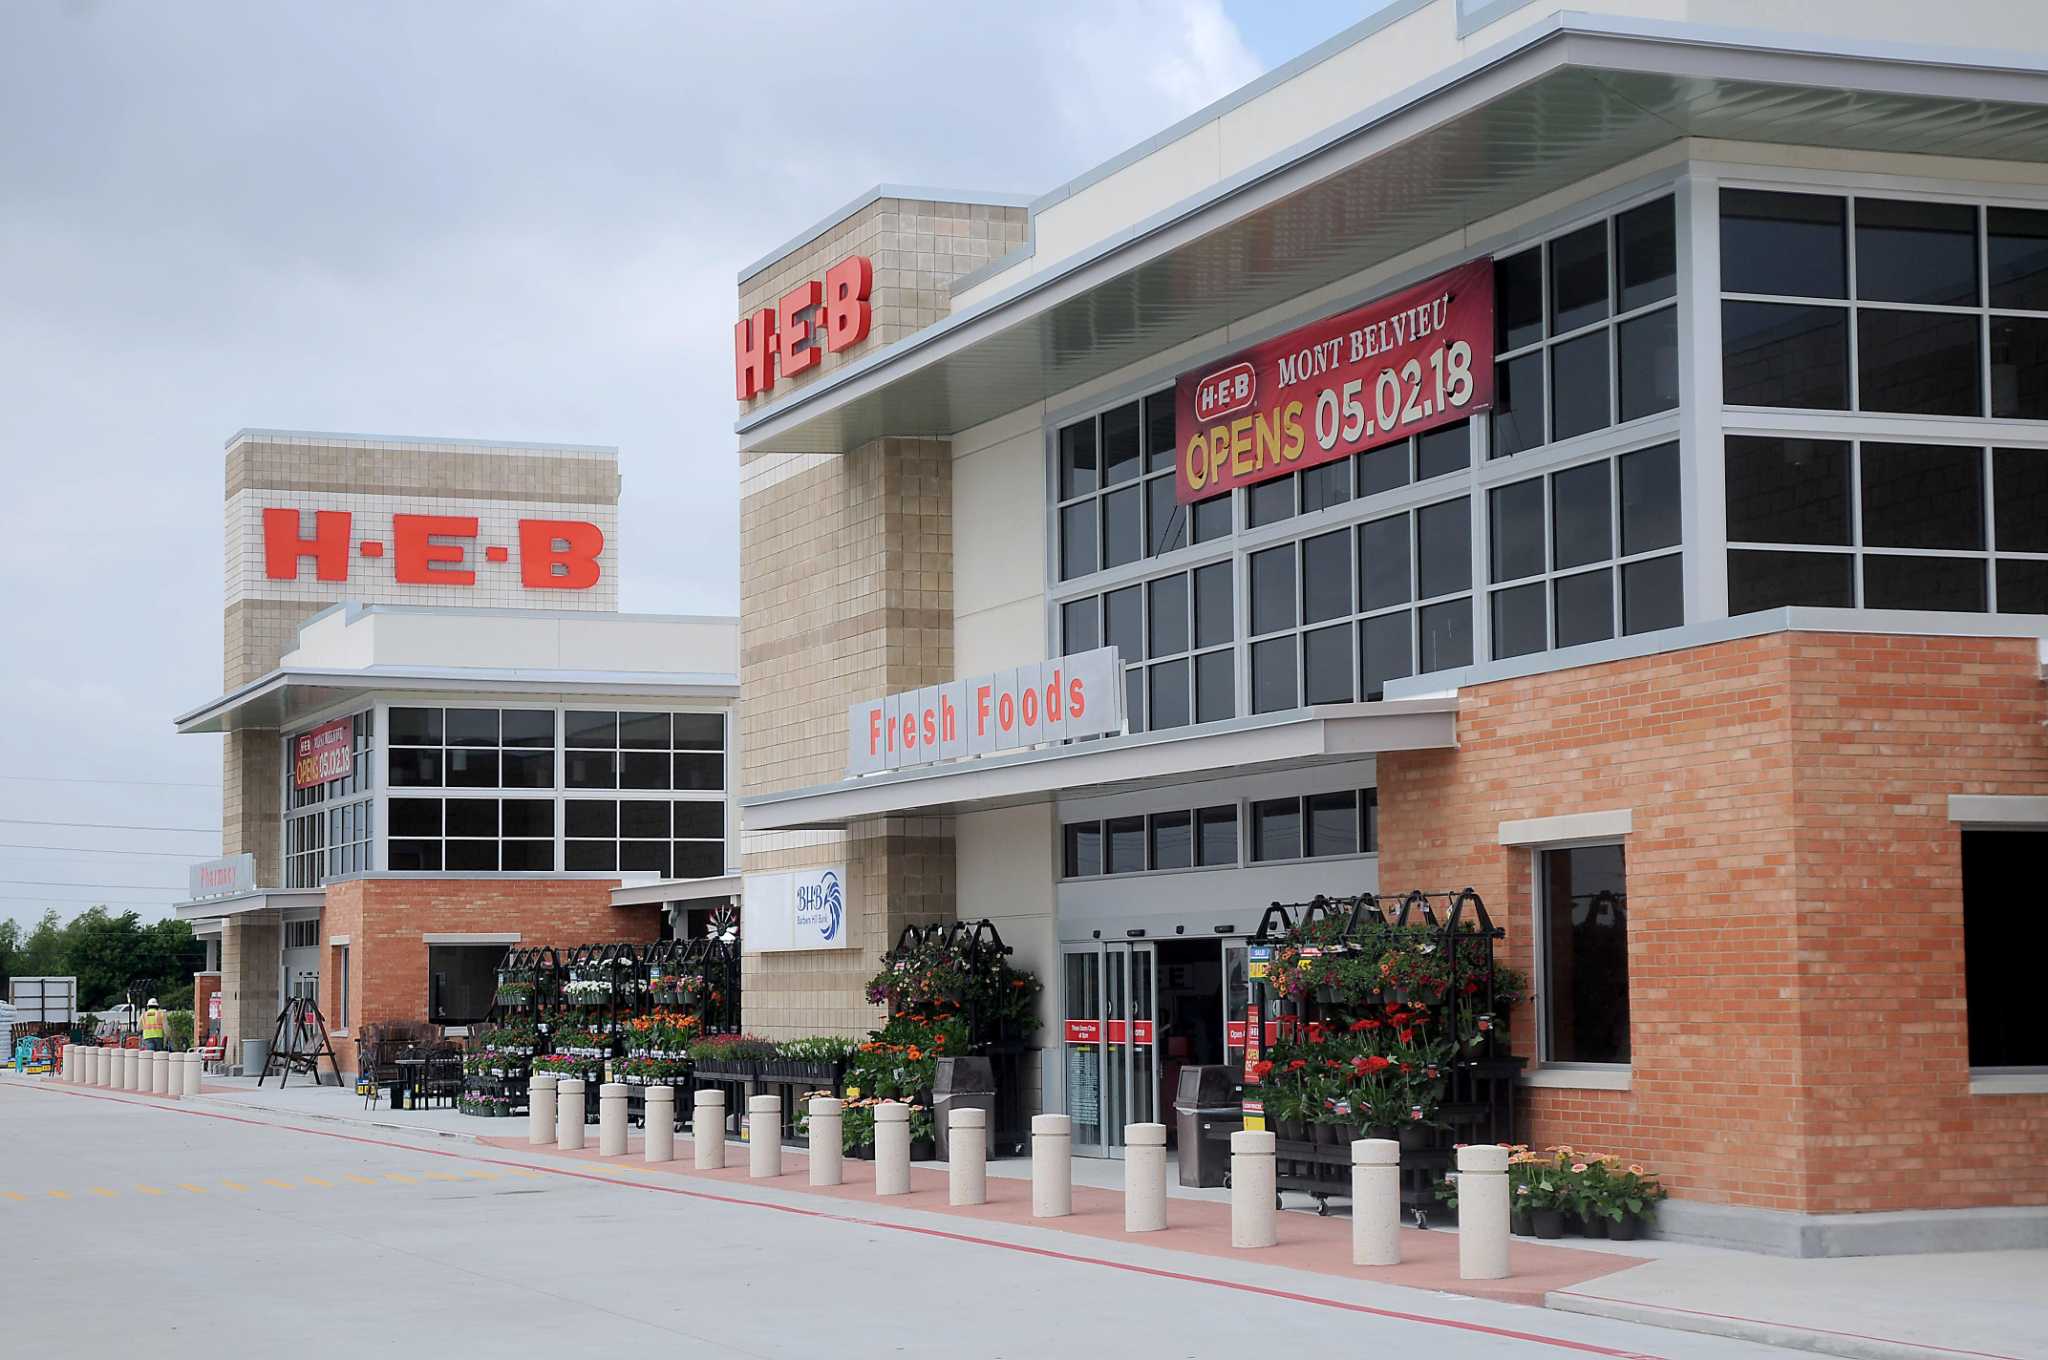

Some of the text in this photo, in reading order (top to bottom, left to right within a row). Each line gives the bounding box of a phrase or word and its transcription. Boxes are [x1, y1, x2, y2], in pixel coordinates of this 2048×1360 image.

[1278, 294, 1449, 388] MONT BELVIEU
[1186, 340, 1473, 490] OPENS 05.02.18
[263, 508, 604, 589] H-E-B
[870, 670, 1086, 756] Fresh Foods
[797, 884, 823, 911] BHB
